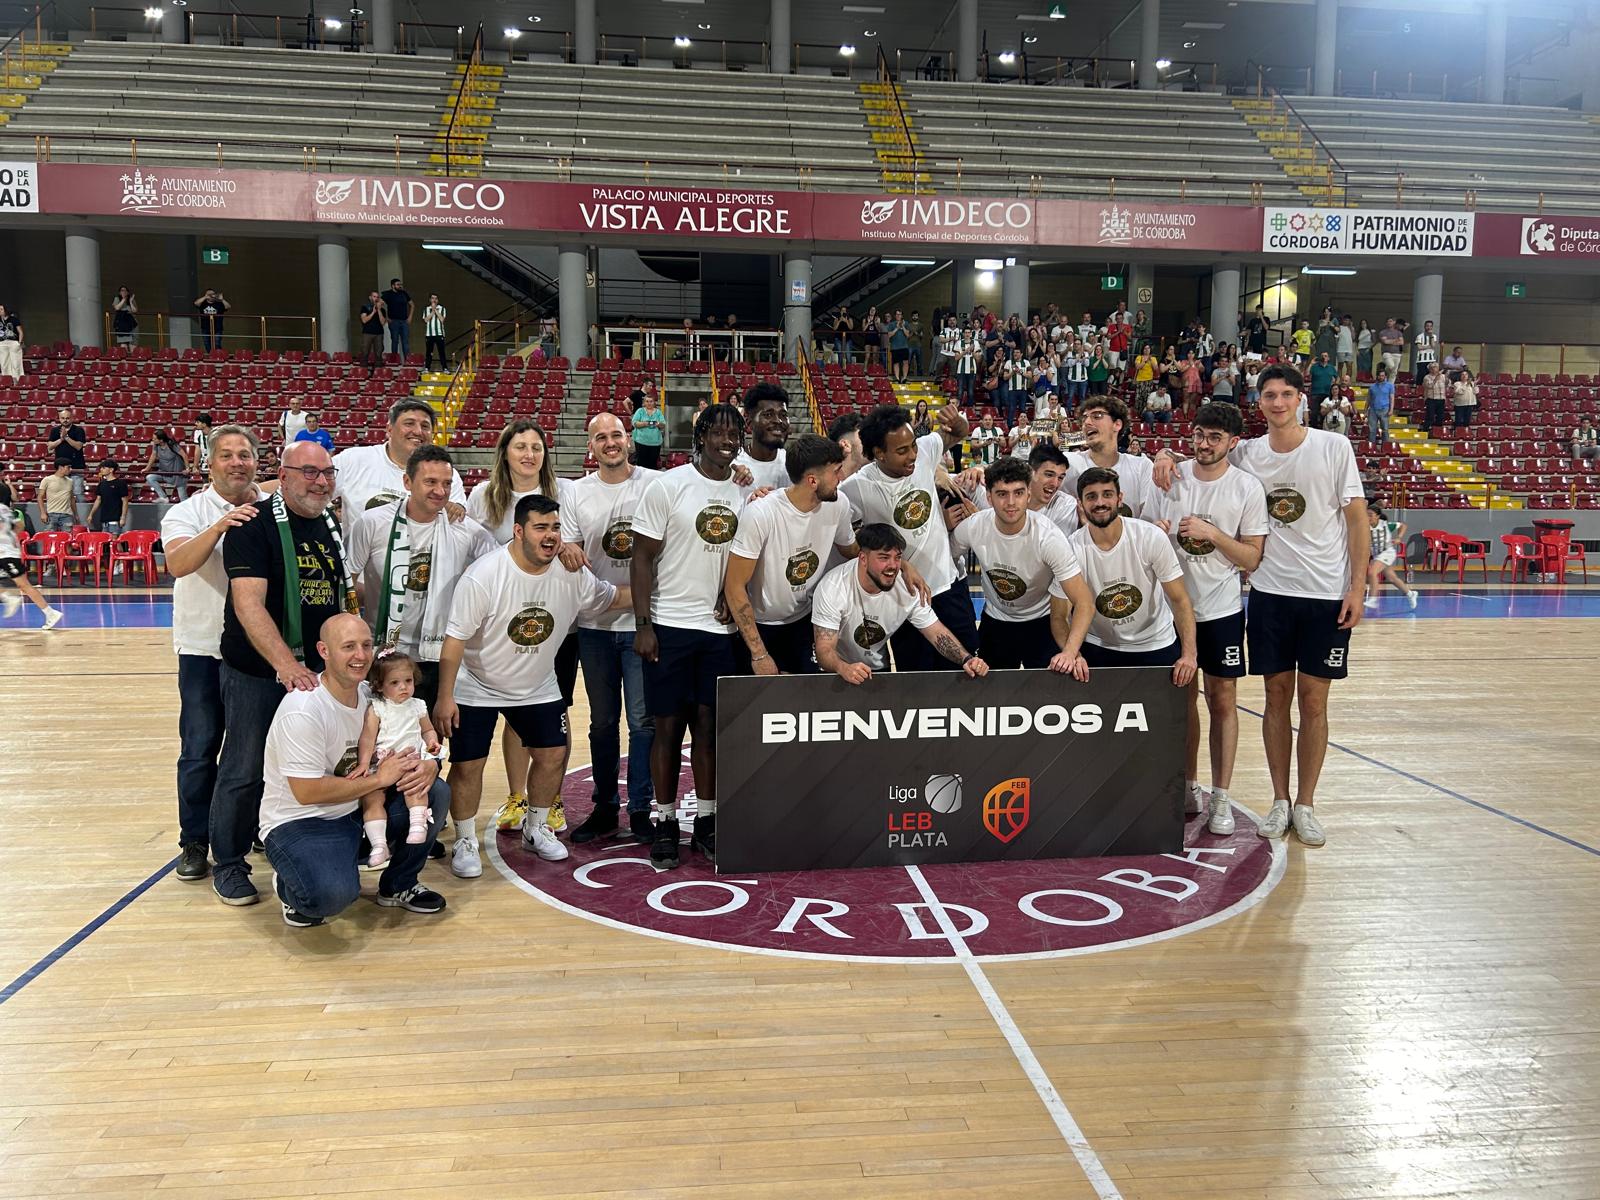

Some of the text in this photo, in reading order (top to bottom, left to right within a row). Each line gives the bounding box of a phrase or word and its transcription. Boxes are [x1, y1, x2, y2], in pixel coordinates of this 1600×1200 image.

[17, 169, 29, 178] DE
[17, 178, 30, 187] LA
[161, 177, 236, 194] AYUNTAMIENTO
[161, 192, 226, 208] DE CÓRDOBA
[360, 179, 505, 212] IMDECO
[592, 188, 774, 206] PALACIO MUNICIPAL DEPORTES
[316, 209, 504, 227] Instituto Municipal de Deportes Córdoba
[579, 203, 792, 235] VISTA ALEGRE
[901, 199, 1032, 229] IMDECO
[1133, 212, 1196, 226] AYUNTAMIENTO
[1458, 218, 1468, 226] DE
[1353, 215, 1455, 233] PATRIMONIO
[861, 229, 896, 239] Instituto
[898, 230, 940, 241] Municipal
[941, 231, 952, 240] de
[954, 232, 993, 243] Deportes
[1133, 226, 1187, 240] DE CÓRDOBA
[1269, 232, 1339, 249] CÓRDOBA
[1352, 233, 1468, 251] HUMANIDAD
[1560, 241, 1574, 252] de
[210, 249, 221, 261] B
[1107, 276, 1118, 288] D
[1511, 284, 1520, 295] E
[1112, 616, 1135, 627] PLATA
[515, 646, 540, 655] PLATA
[761, 703, 1149, 744] BIENVENIDOS A
[1011, 781, 1027, 789] FEB
[889, 785, 917, 803] Liga
[888, 812, 932, 831] LEB
[888, 832, 948, 849] PLATA
